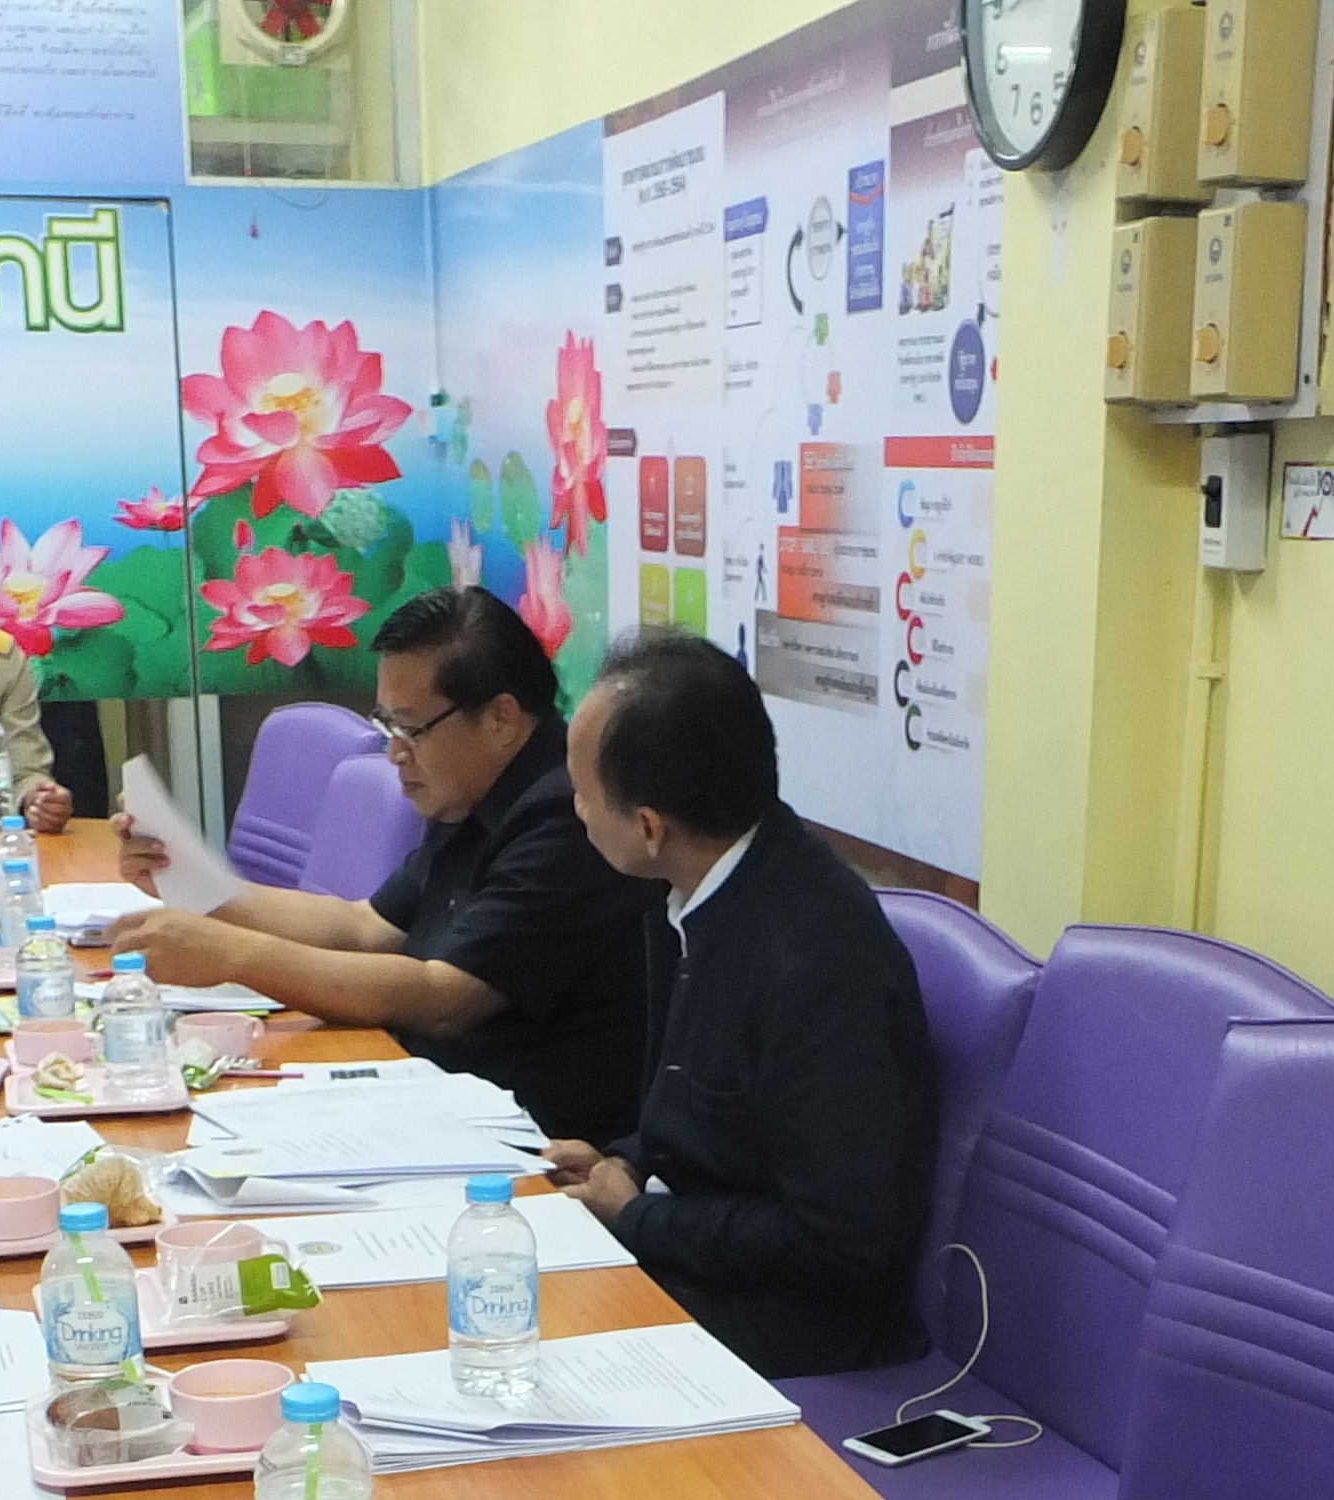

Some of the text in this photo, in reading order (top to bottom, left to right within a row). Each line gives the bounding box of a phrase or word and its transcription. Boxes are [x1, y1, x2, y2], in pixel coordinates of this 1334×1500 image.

[1010, 84, 1021, 118] 7
[1030, 91, 1043, 125] 6
[472, 1296, 528, 1317] Drinking
[62, 1323, 121, 1345] Drinking
